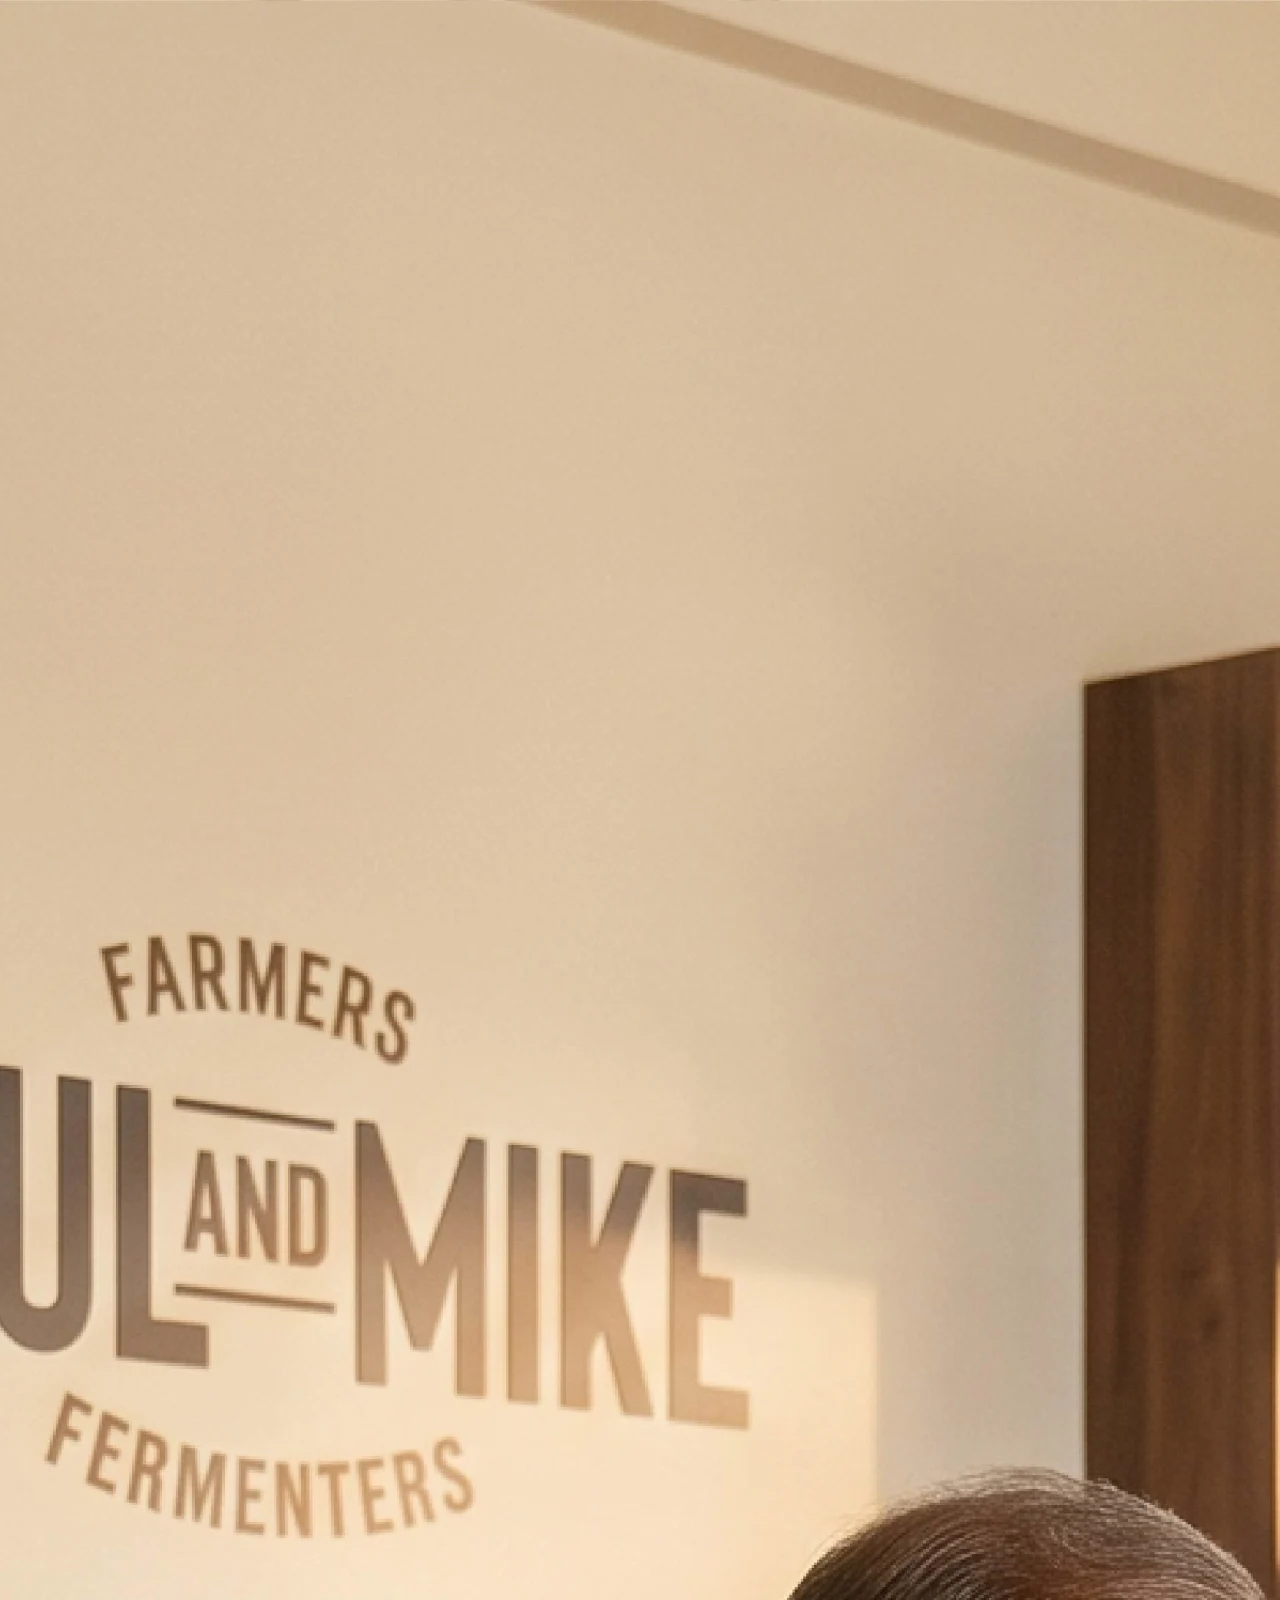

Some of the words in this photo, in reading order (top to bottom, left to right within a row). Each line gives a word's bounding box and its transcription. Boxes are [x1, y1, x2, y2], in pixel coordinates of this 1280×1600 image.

[98, 931, 417, 1067] FARMERS
[182, 1149, 329, 1268] AND
[353, 1119, 751, 1431] MIKE
[43, 1389, 476, 1539] FERMENTERS
